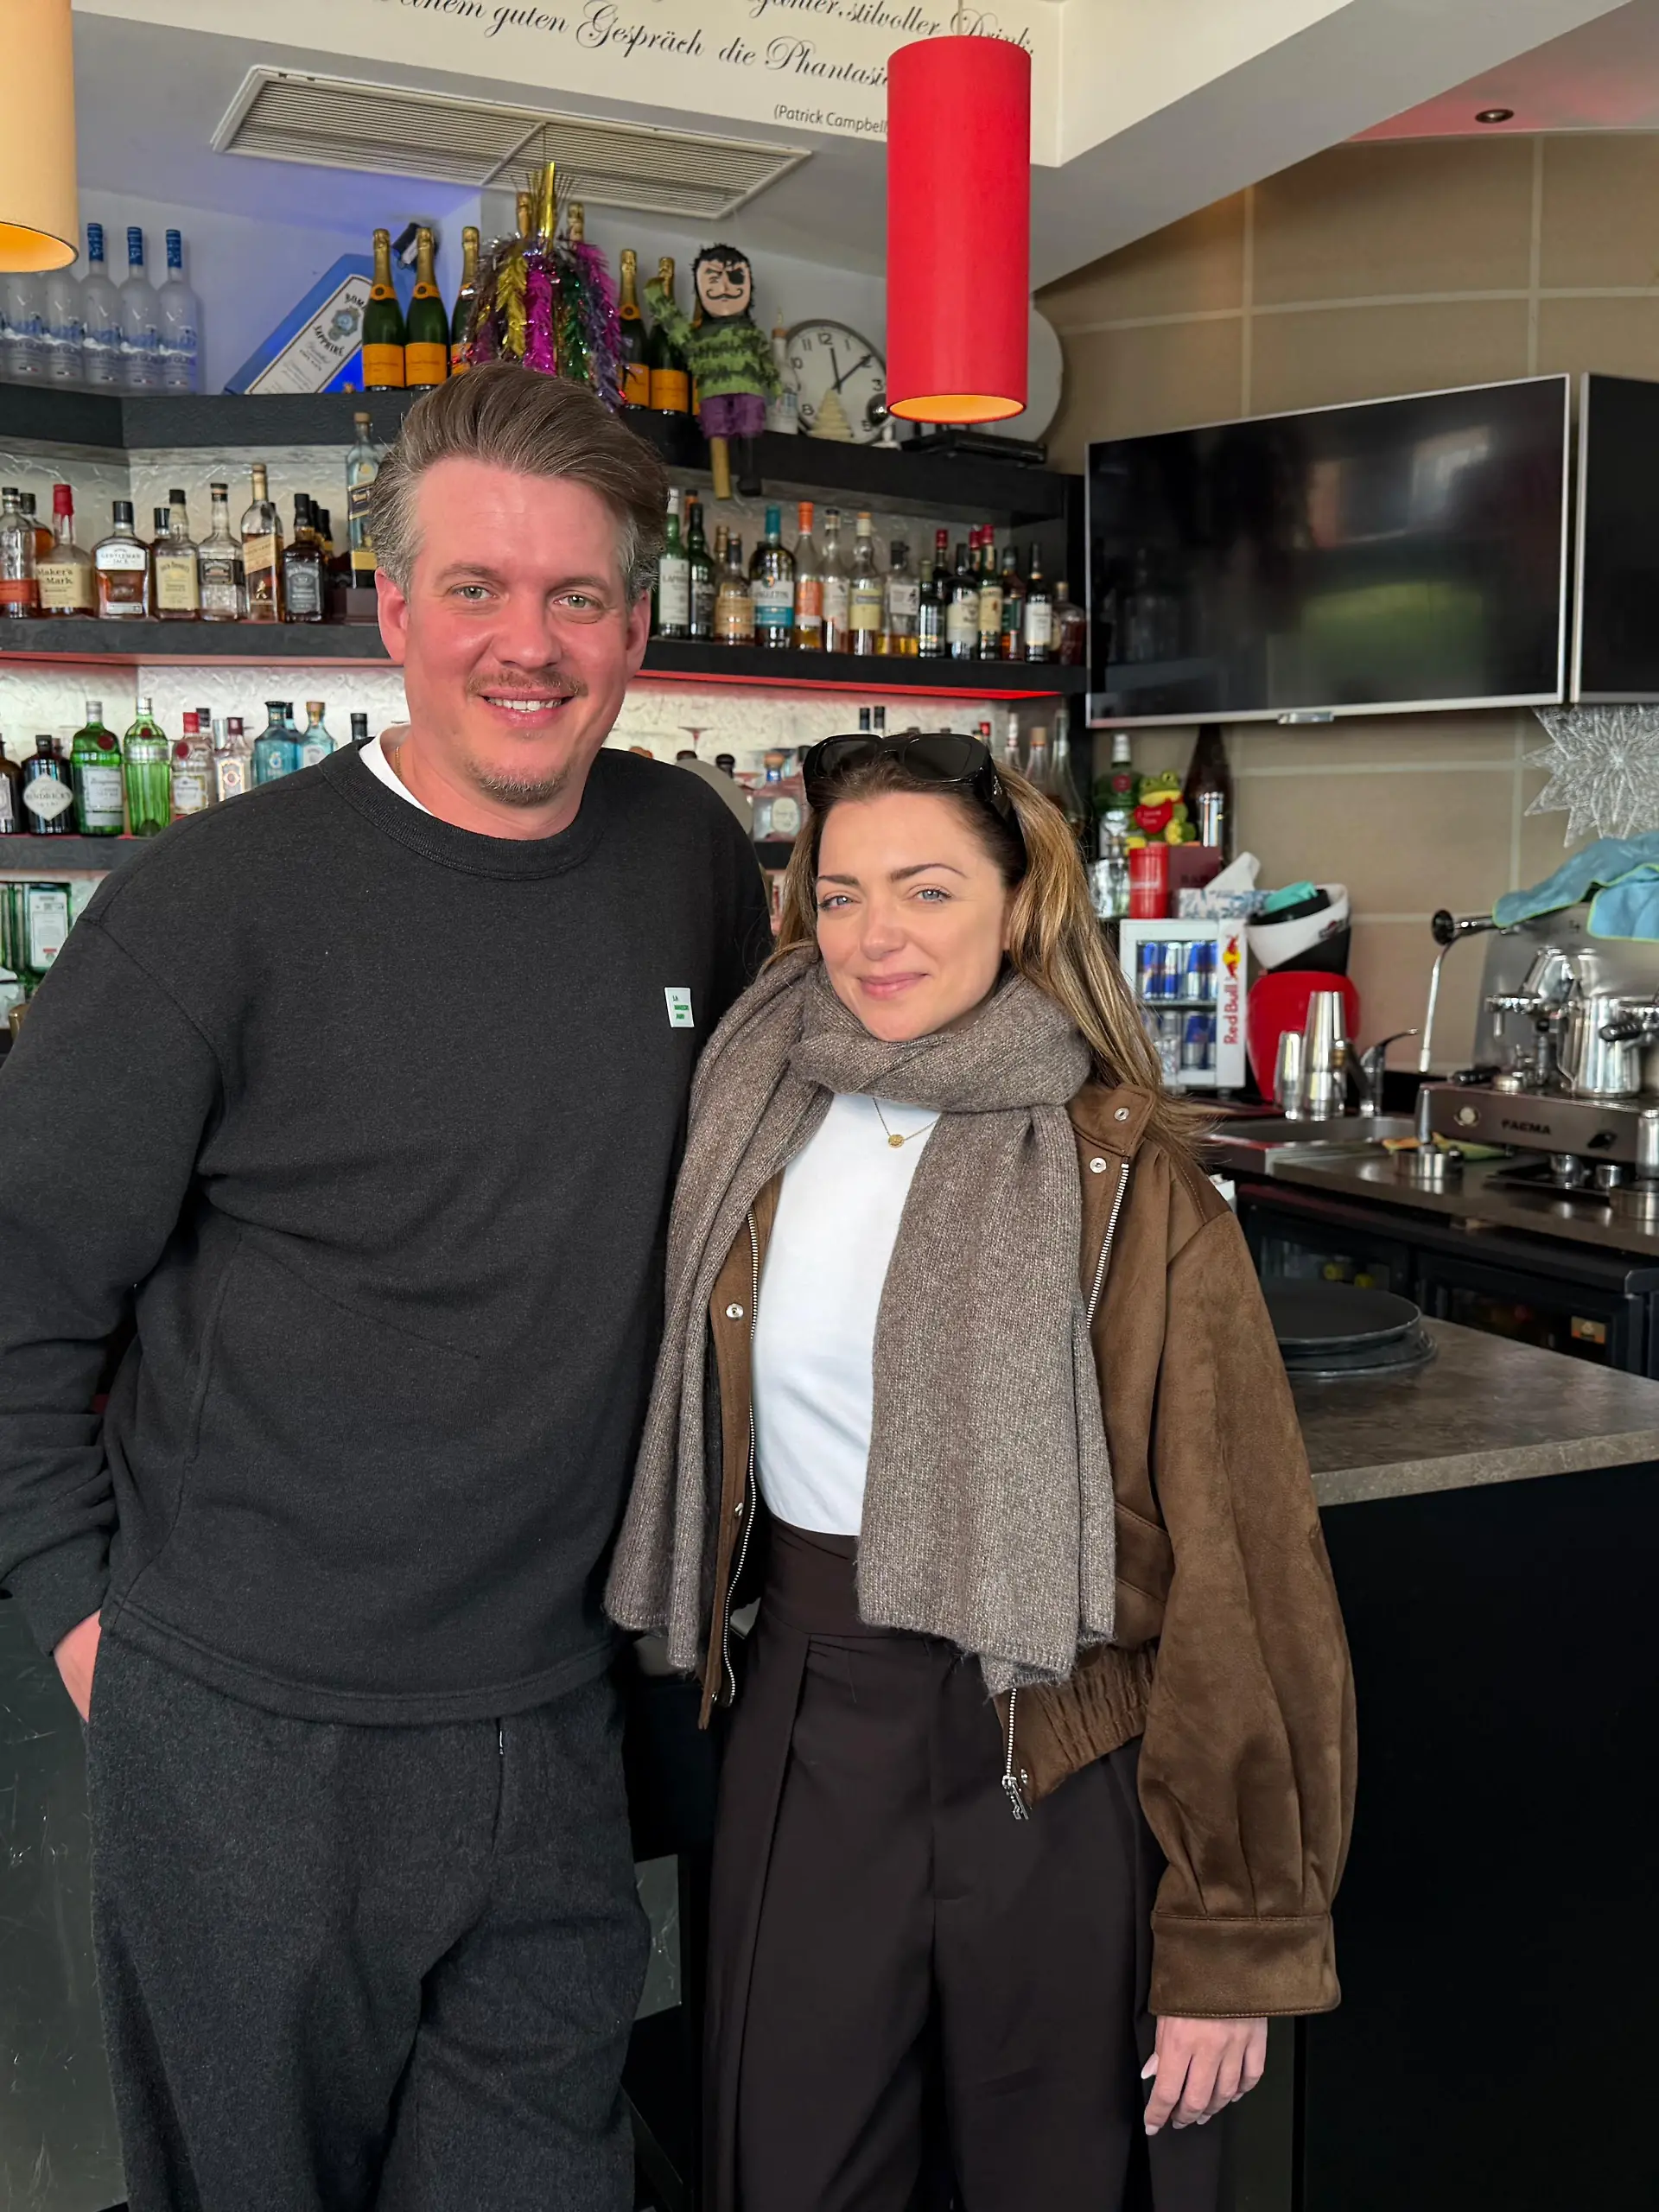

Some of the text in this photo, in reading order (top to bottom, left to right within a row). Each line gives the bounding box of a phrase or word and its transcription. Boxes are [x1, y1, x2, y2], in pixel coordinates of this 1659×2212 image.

[484, 7, 569, 38] guten
[575, 0, 704, 58] Gespräch
[718, 37, 757, 66] die
[764, 35, 888, 86] Phantasi
[774, 104, 823, 124] (Patrick
[817, 332, 833, 346] 12
